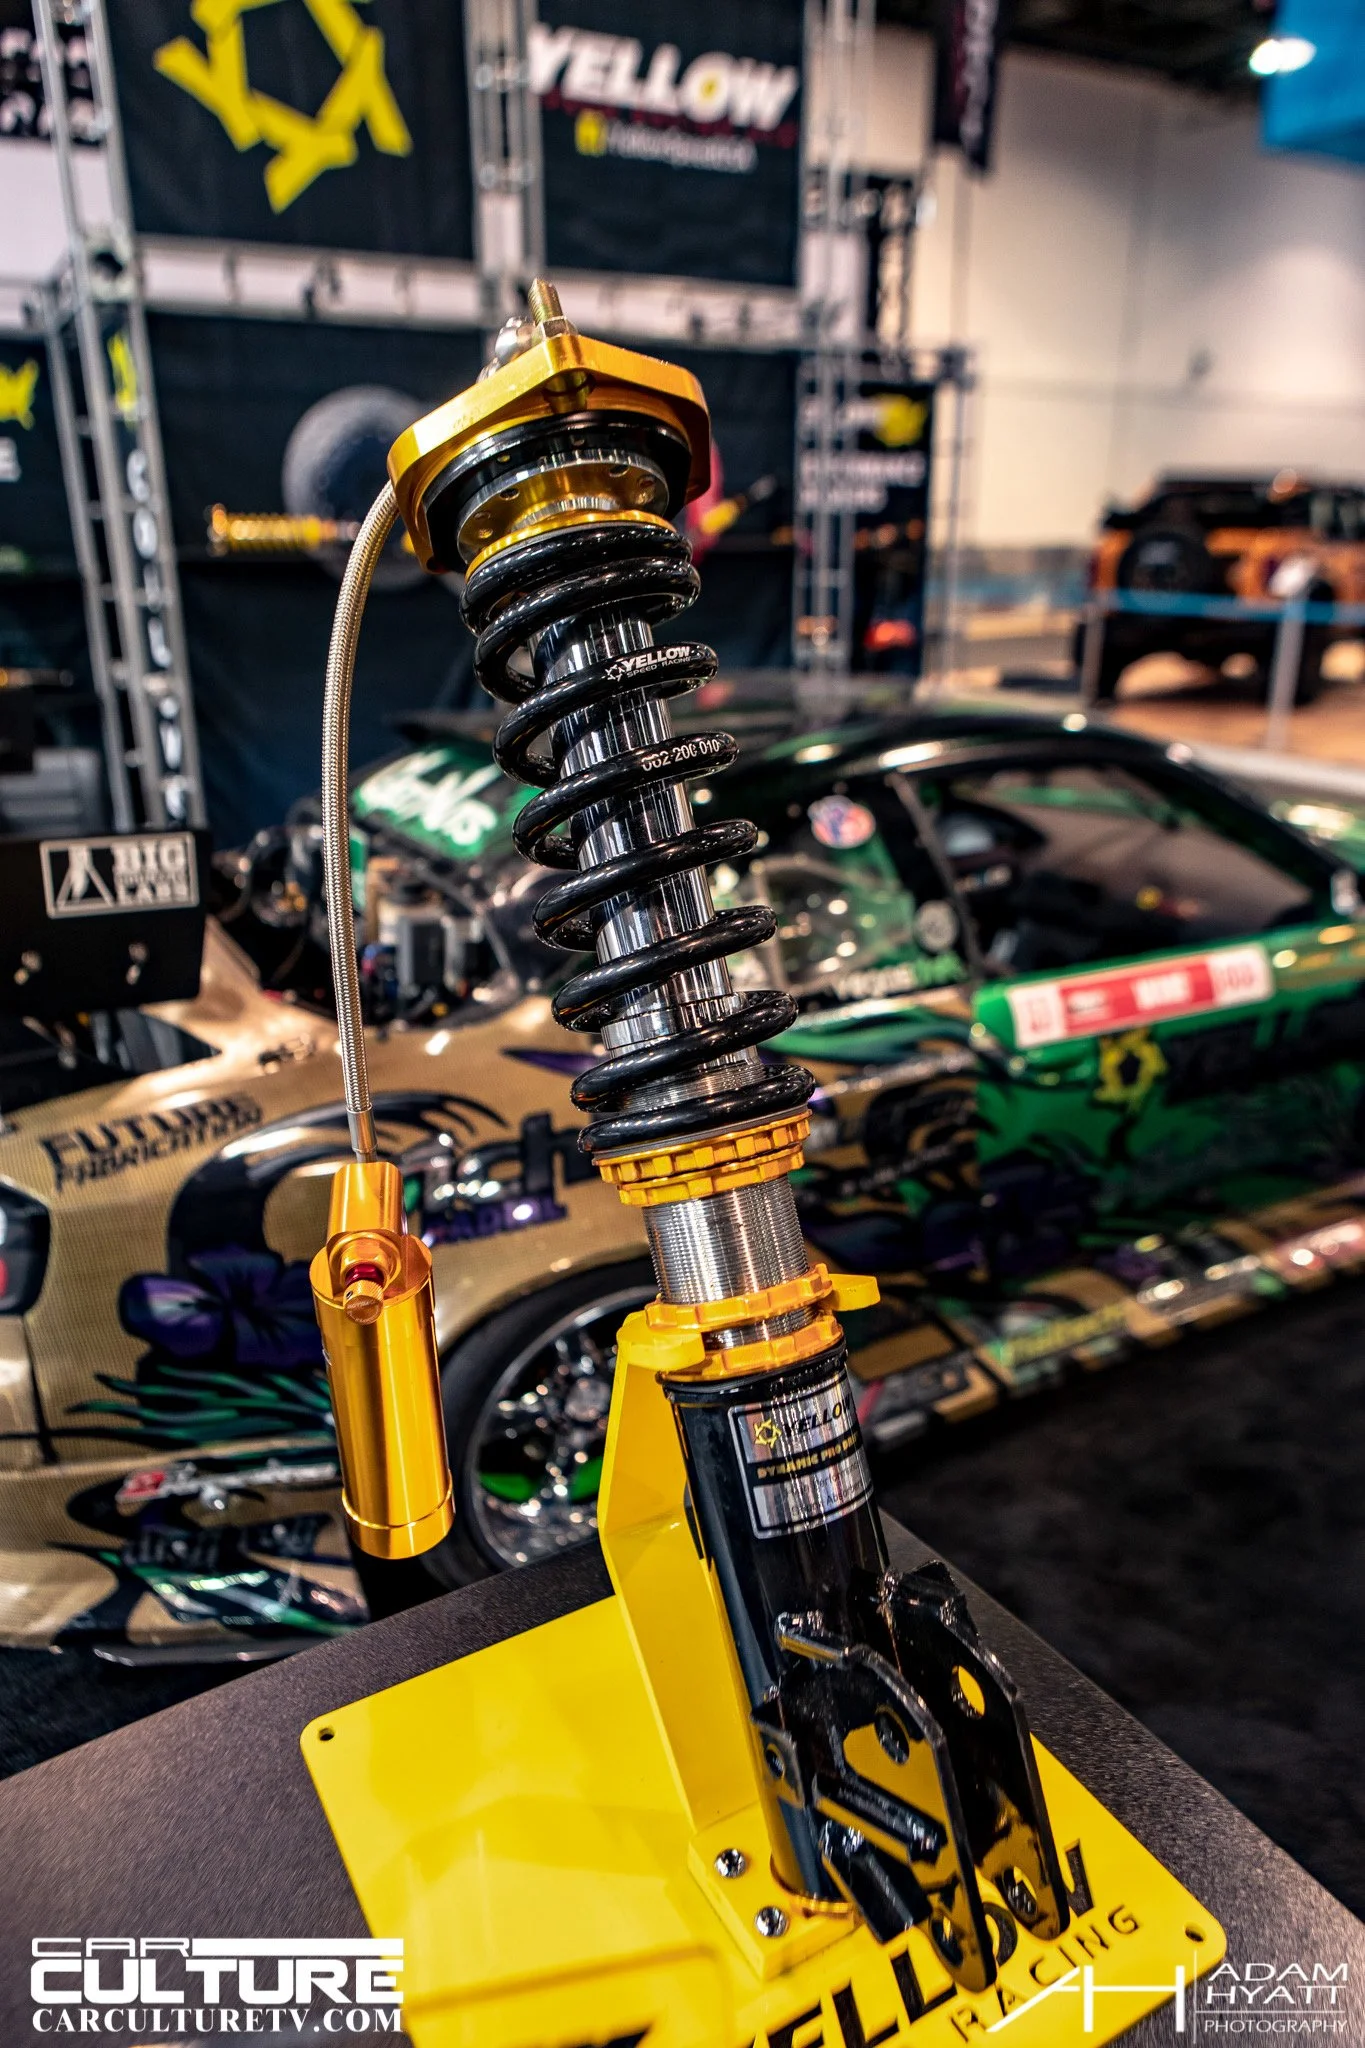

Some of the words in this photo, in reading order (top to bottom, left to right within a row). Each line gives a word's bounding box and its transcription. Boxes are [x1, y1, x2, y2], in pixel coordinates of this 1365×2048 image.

[527, 22, 799, 131] YELLOW
[622, 646, 690, 672] YELLOW
[626, 664, 658, 679] SPEED
[661, 656, 692, 668] RACING
[783, 1393, 853, 1438] YELLOW
[757, 1453, 819, 1479] DYNAMIC
[820, 1445, 841, 1461] PRO
